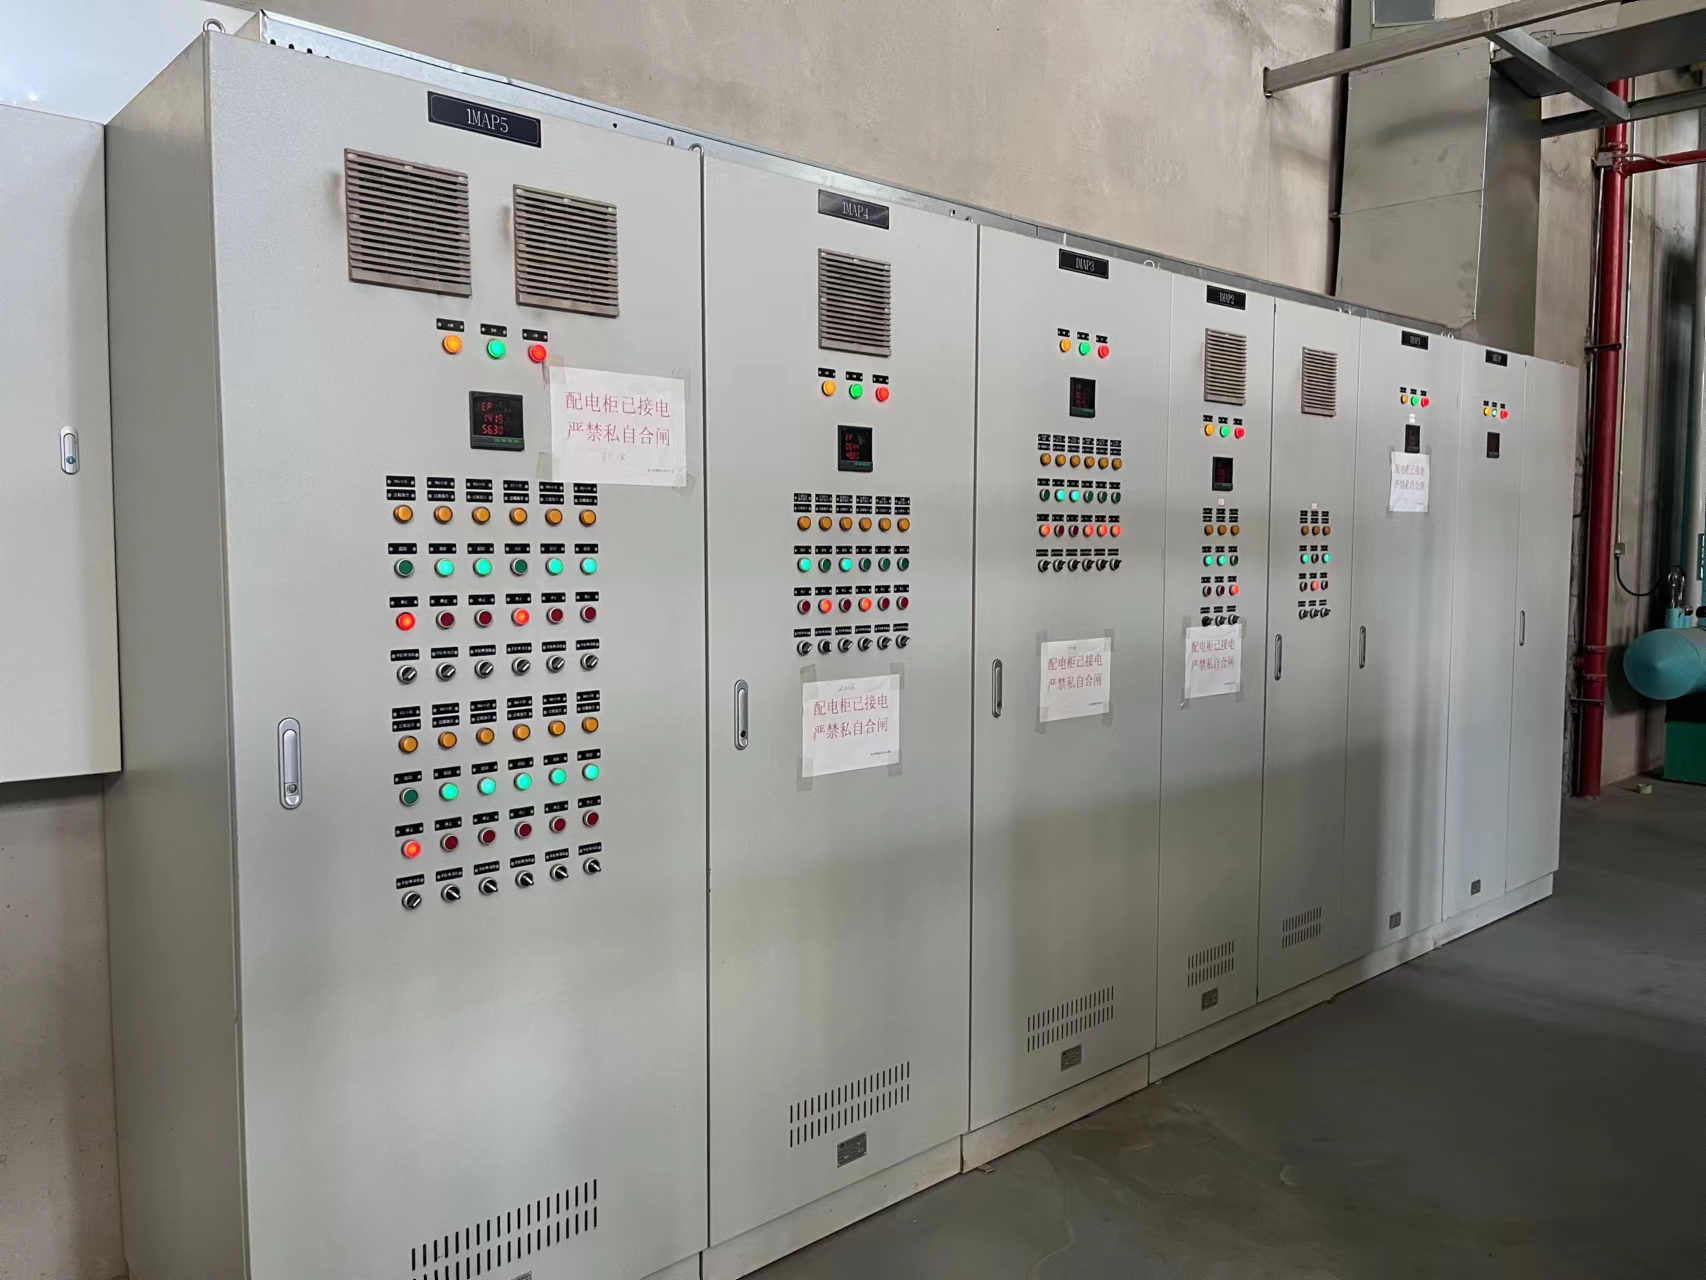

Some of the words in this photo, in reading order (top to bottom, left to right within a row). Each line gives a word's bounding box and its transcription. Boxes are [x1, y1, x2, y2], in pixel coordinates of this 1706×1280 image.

[466, 108, 509, 133] 1MAP5
[842, 201, 869, 220] 1MAP4
[1075, 257, 1095, 272] 1MAP3
[565, 391, 671, 418] 配电柜已接电
[566, 421, 671, 446] 严禁私自合闸
[1048, 653, 1103, 671] 配电柜已接电
[1048, 673, 1102, 691] 严禁私自合闸
[813, 692, 889, 717] 配电柜已接电
[813, 717, 888, 741] 严禁私自合闸
